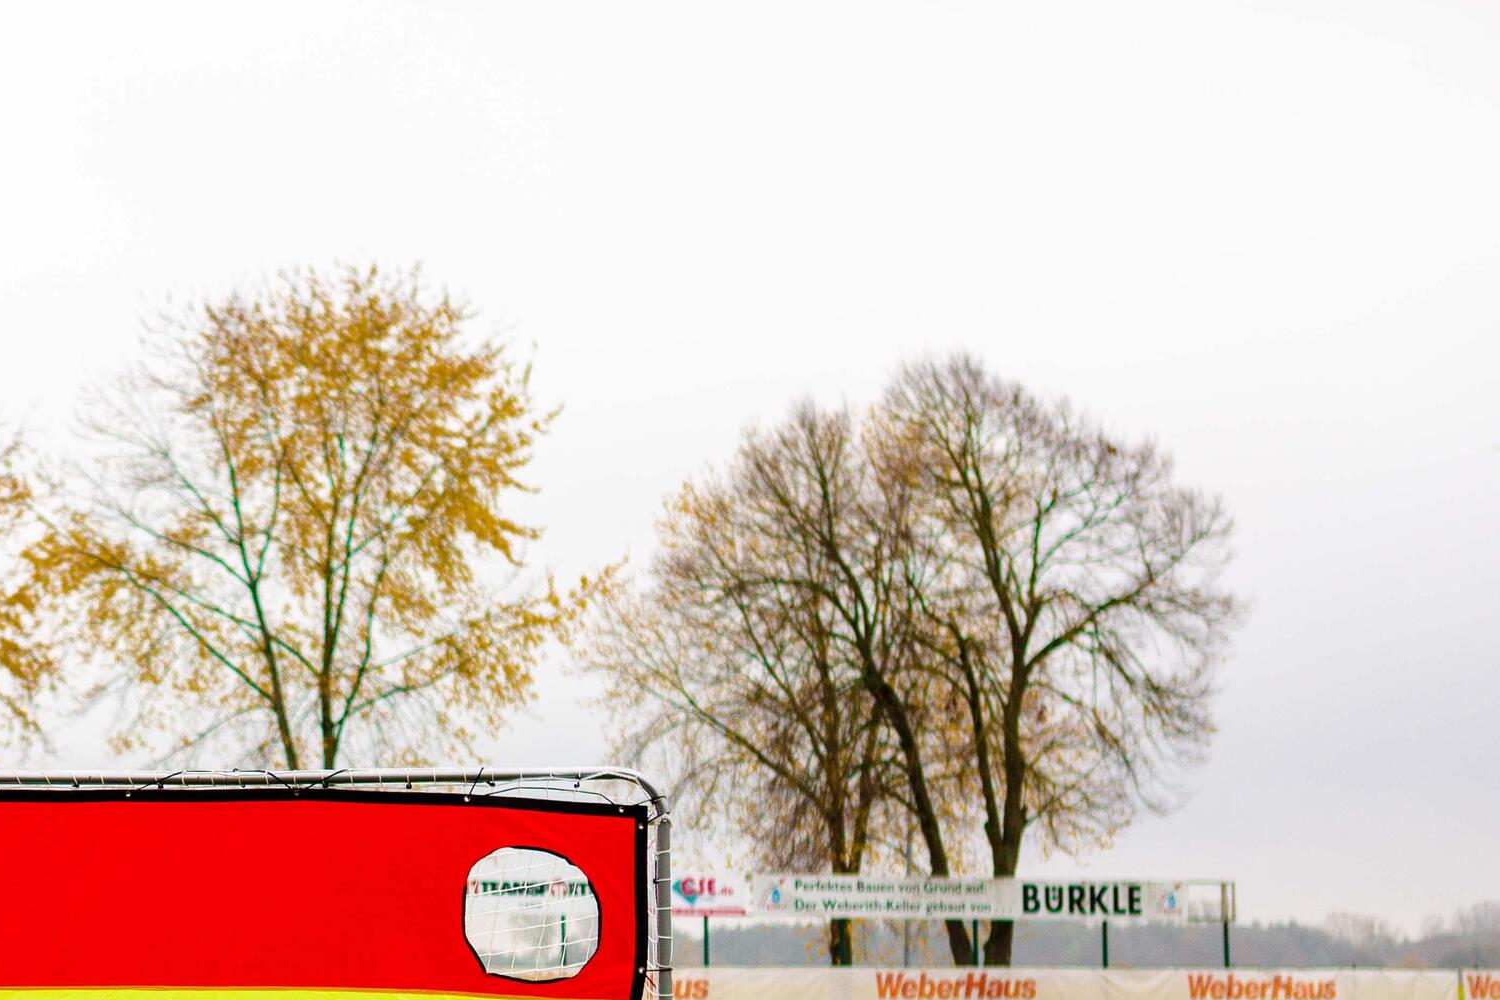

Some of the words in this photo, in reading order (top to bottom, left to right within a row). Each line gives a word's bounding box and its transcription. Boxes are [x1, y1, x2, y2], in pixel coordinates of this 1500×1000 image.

[794, 880, 853, 892] Perfektes
[857, 881, 894, 893] Bauen
[898, 885, 920, 893] von
[924, 881, 962, 893] Grund
[965, 881, 985, 893] auf
[1022, 882, 1142, 915] BÜRKLE
[794, 899, 817, 912] Der
[926, 900, 965, 914] gebaut
[970, 903, 991, 912] von
[875, 972, 1037, 1000] WeberHaus
[1188, 974, 1336, 1000] WeberHaus
